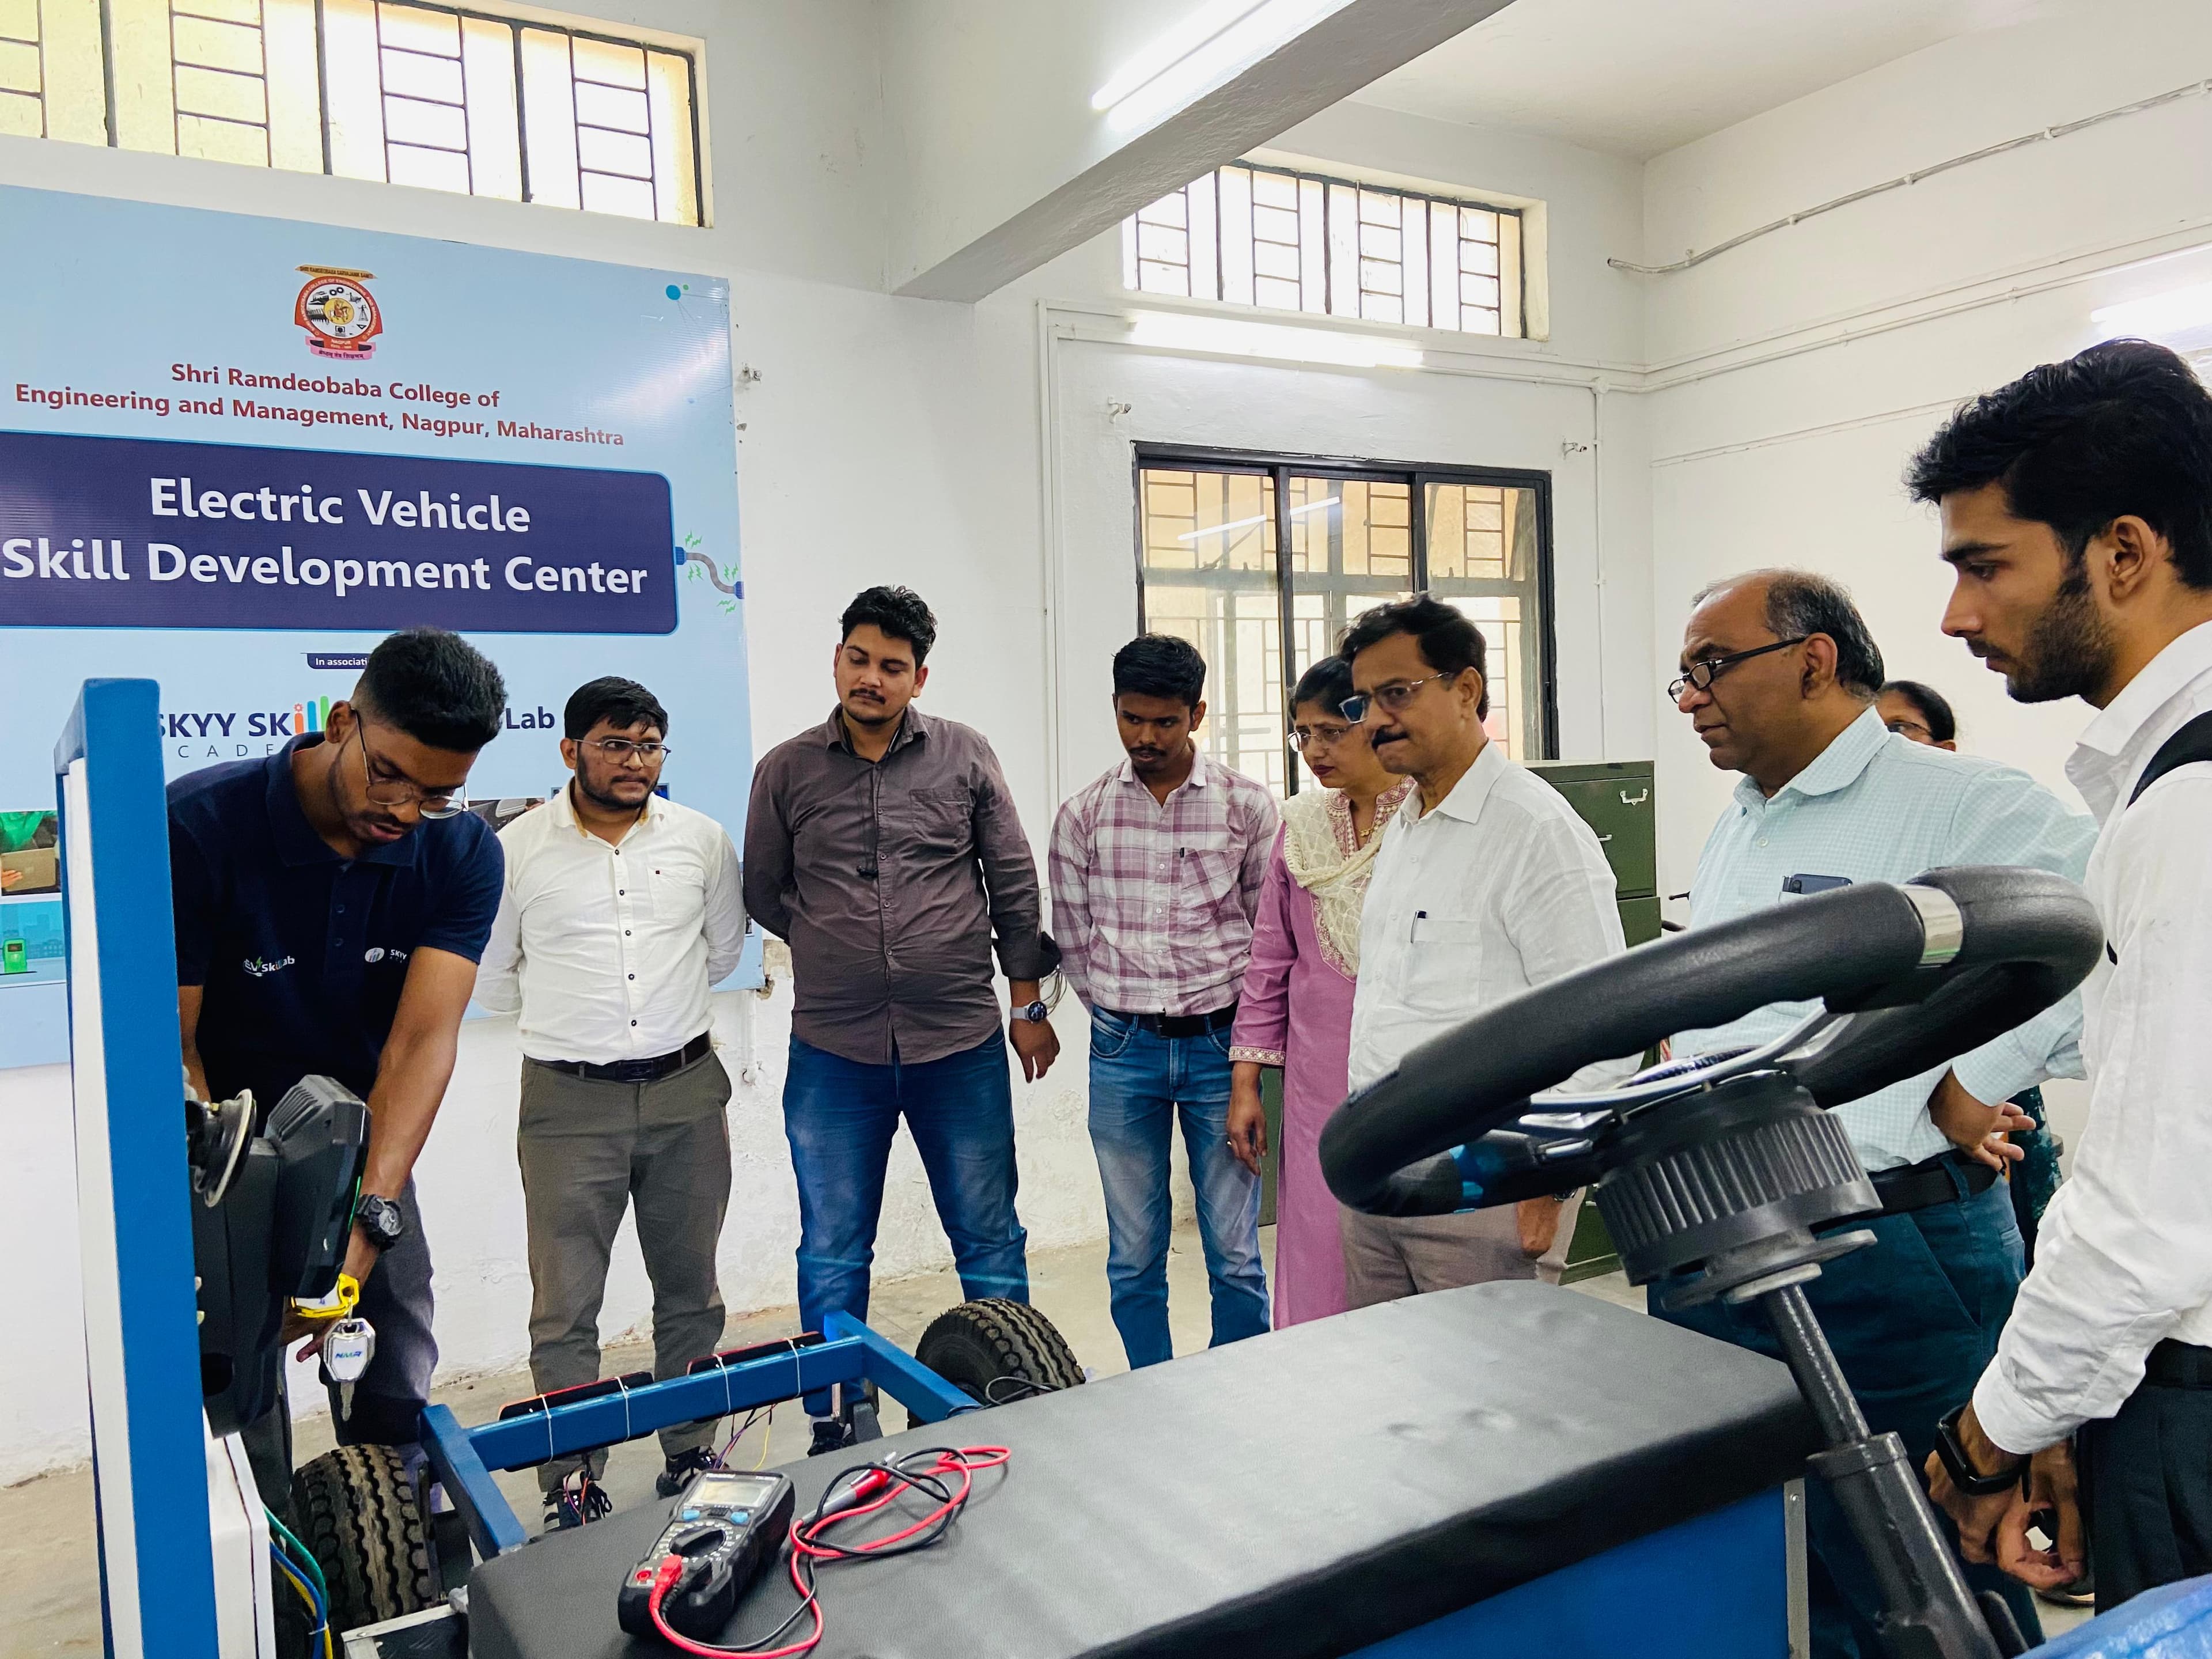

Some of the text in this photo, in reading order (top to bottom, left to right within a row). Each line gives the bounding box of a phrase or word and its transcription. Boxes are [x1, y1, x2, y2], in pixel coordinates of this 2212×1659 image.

[172, 363, 500, 407] Shri Ramdeobaba College of
[16, 383, 624, 446] Engineering and Management, Nagpur, Maharashtra
[151, 478, 531, 533] Electric Vehicle
[2, 537, 648, 597] Skill Development Center
[316, 657, 368, 666] In associati
[506, 706, 555, 729] Lab
[178, 744, 274, 759] CADE
